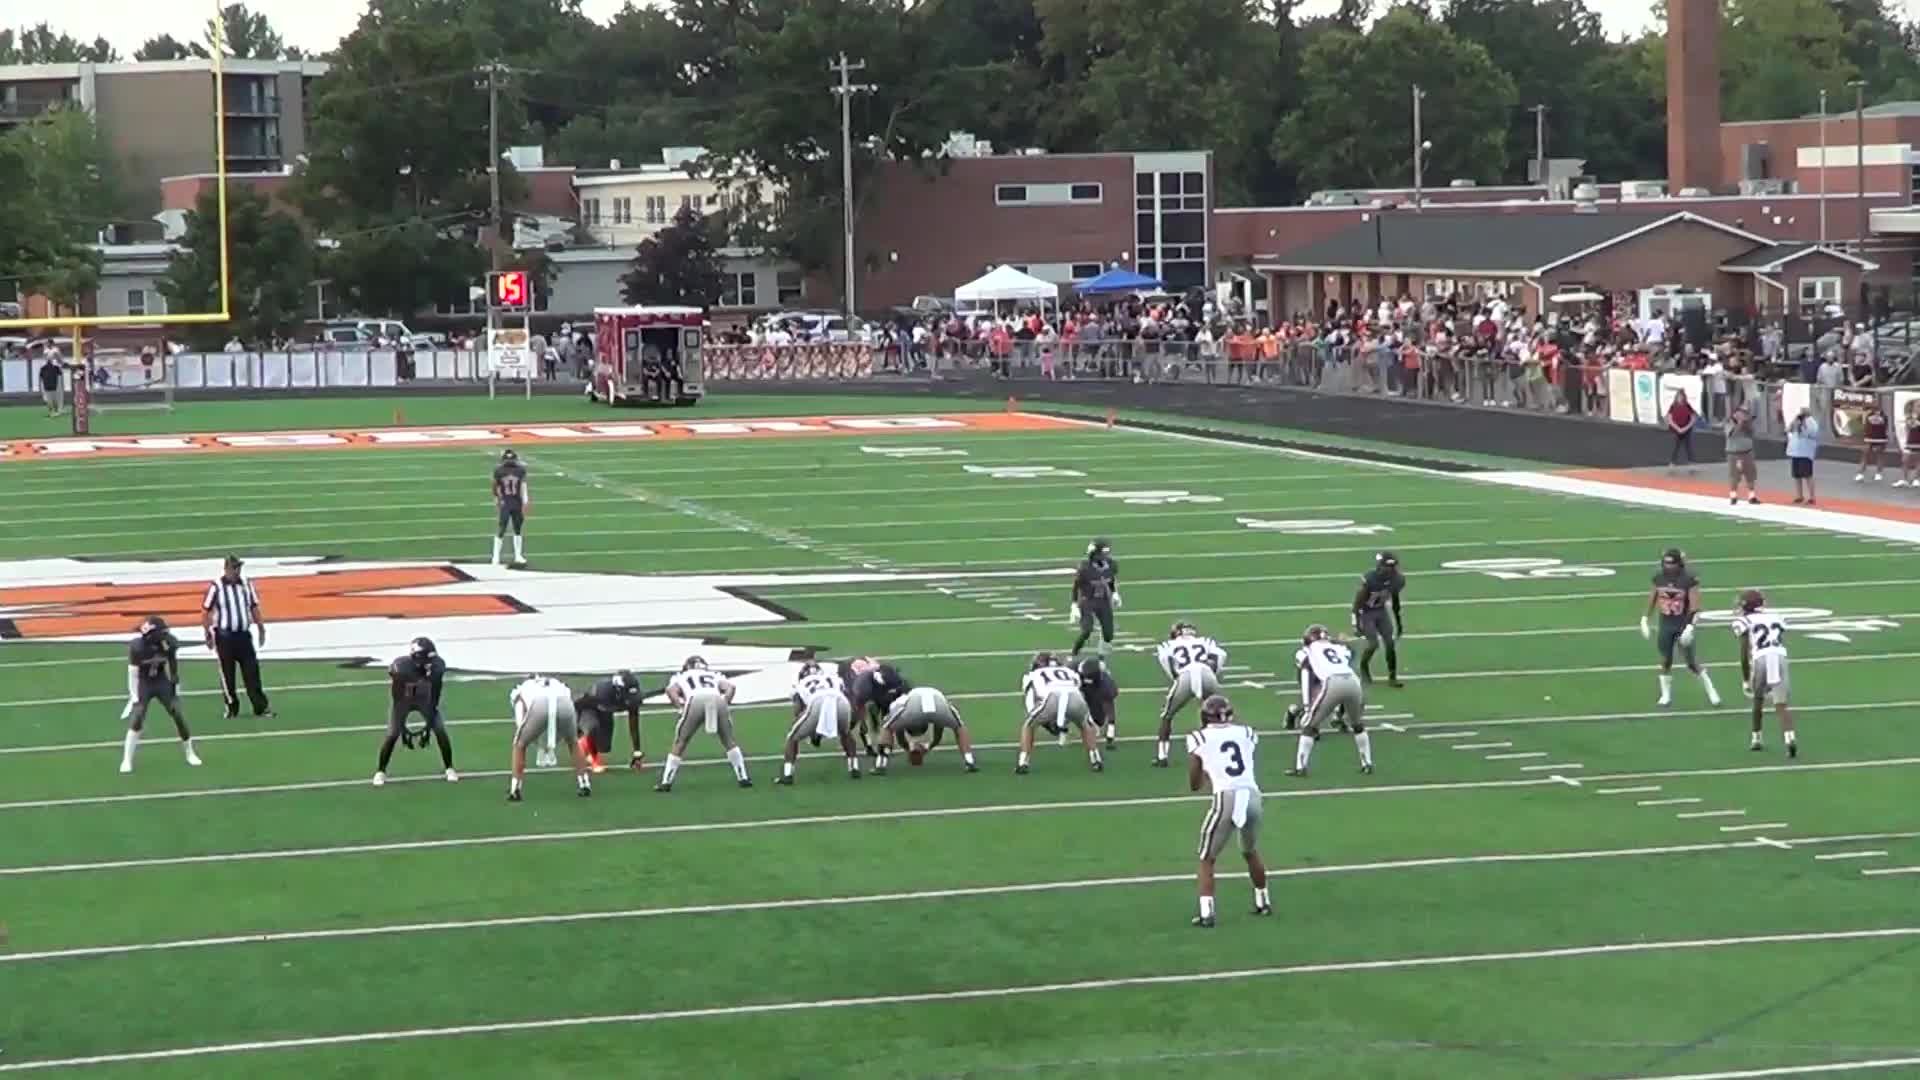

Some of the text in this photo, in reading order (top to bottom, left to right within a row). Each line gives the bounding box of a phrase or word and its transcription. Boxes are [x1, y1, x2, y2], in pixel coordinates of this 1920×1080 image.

[498, 273, 521, 301] 15
[1172, 643, 1209, 669] 32
[1219, 740, 1246, 778] 3
